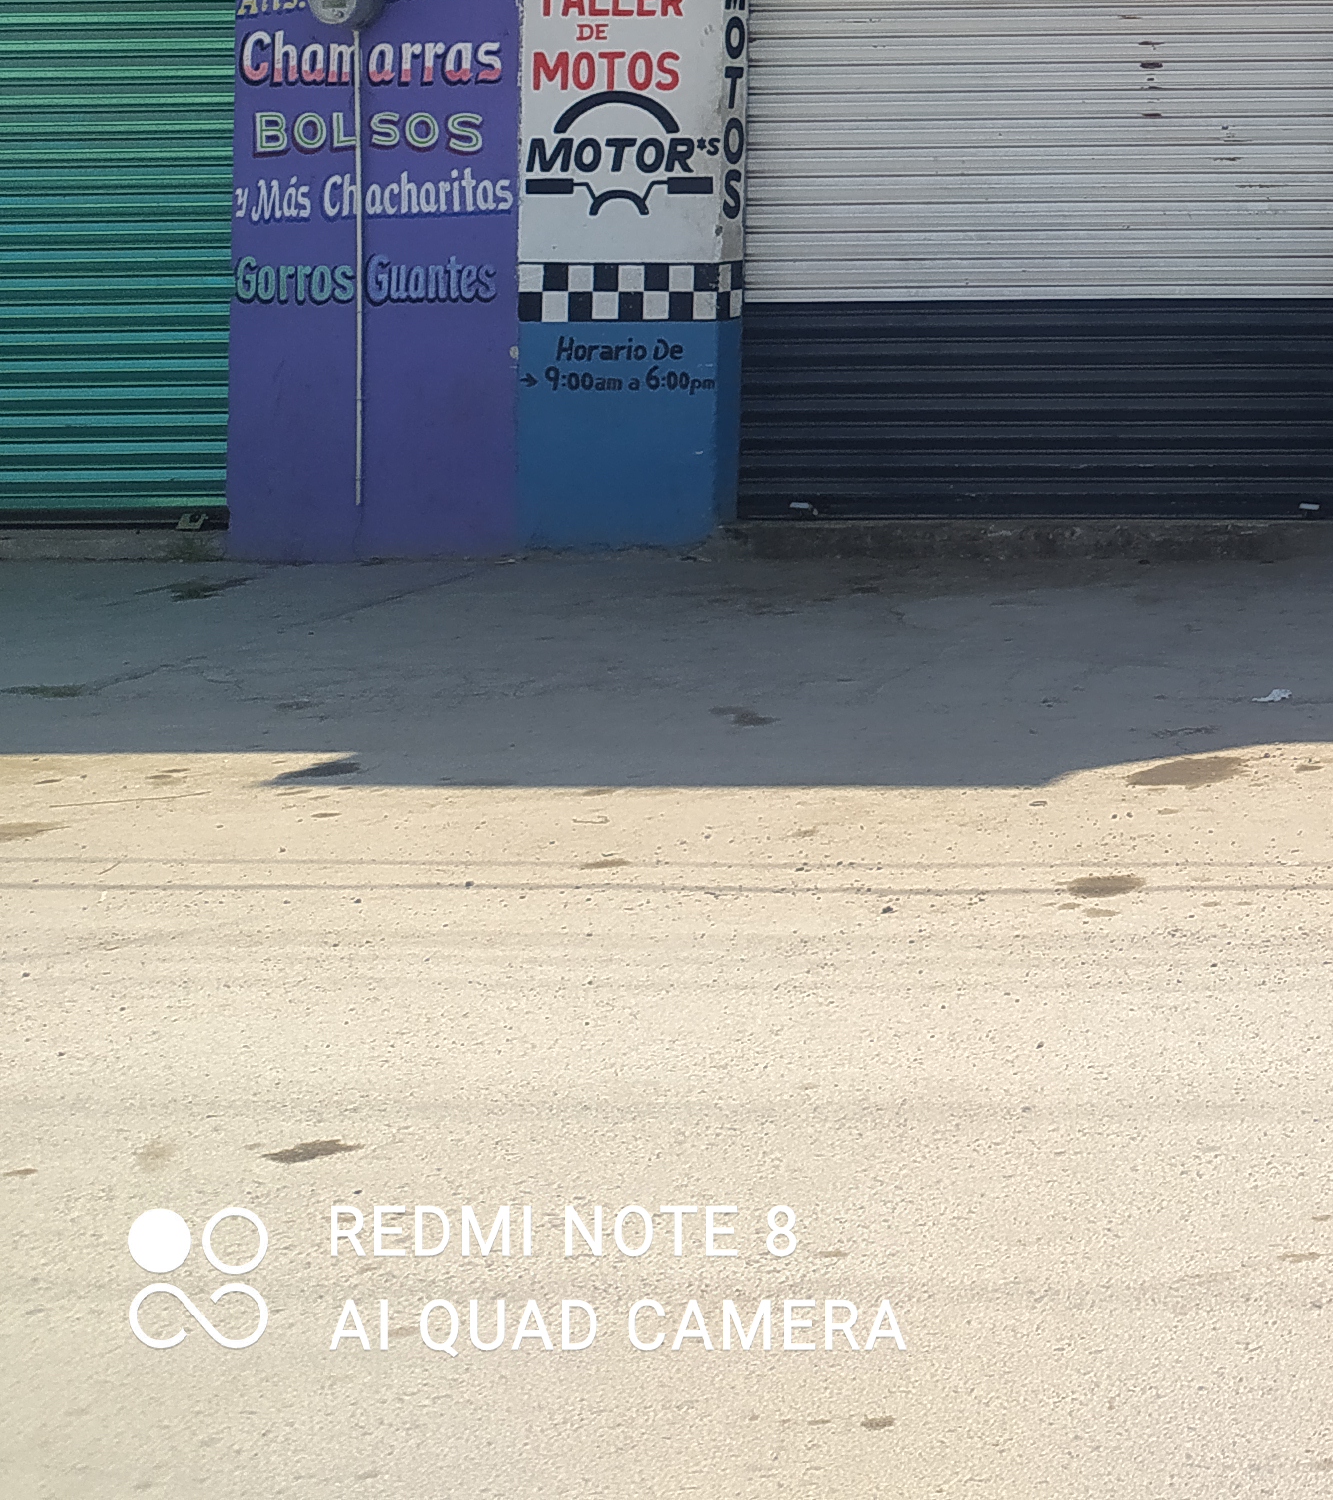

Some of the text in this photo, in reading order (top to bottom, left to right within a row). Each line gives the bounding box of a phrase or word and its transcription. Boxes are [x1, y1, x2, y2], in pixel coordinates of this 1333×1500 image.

[576, 23, 609, 41] DE
[241, 30, 502, 85] Chamarras
[533, 51, 680, 91] MOTOS
[255, 111, 483, 152] BOLSOS
[252, 176, 311, 222] Más
[324, 167, 513, 216] Chacharitas
[235, 254, 498, 302] Gorros Guantes
[556, 336, 684, 361] Horario De
[544, 365, 716, 395] 9:00am a 6:00pm
